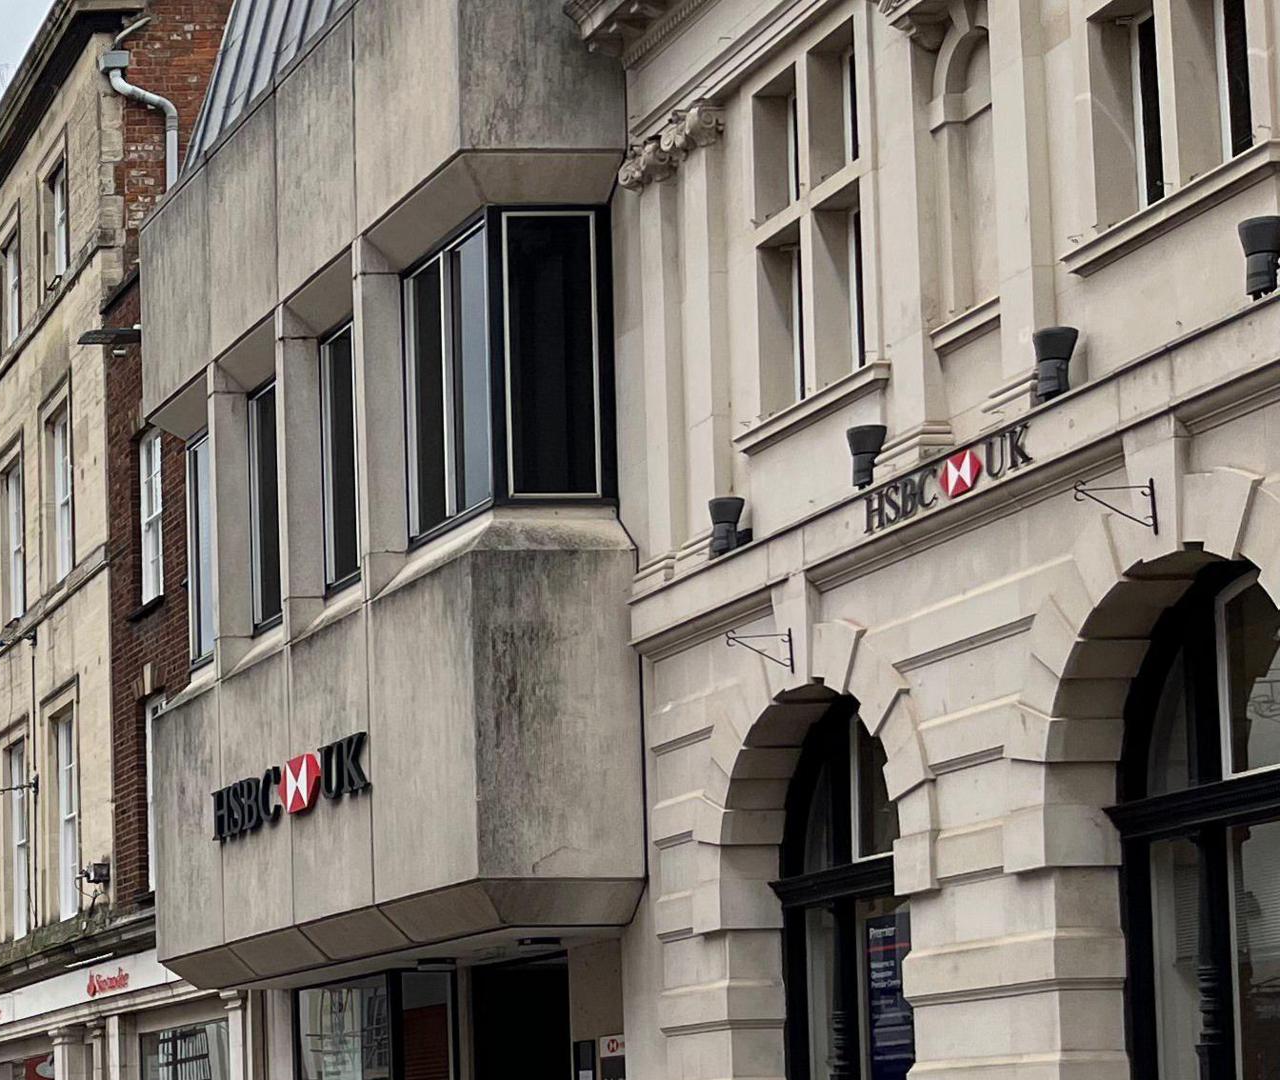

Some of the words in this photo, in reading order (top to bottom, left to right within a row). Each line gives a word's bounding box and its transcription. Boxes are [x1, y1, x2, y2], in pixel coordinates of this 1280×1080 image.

[864, 467, 938, 533] HSBC
[985, 423, 1033, 477] UK
[211, 766, 282, 840] HSBC
[317, 732, 371, 799] UK
